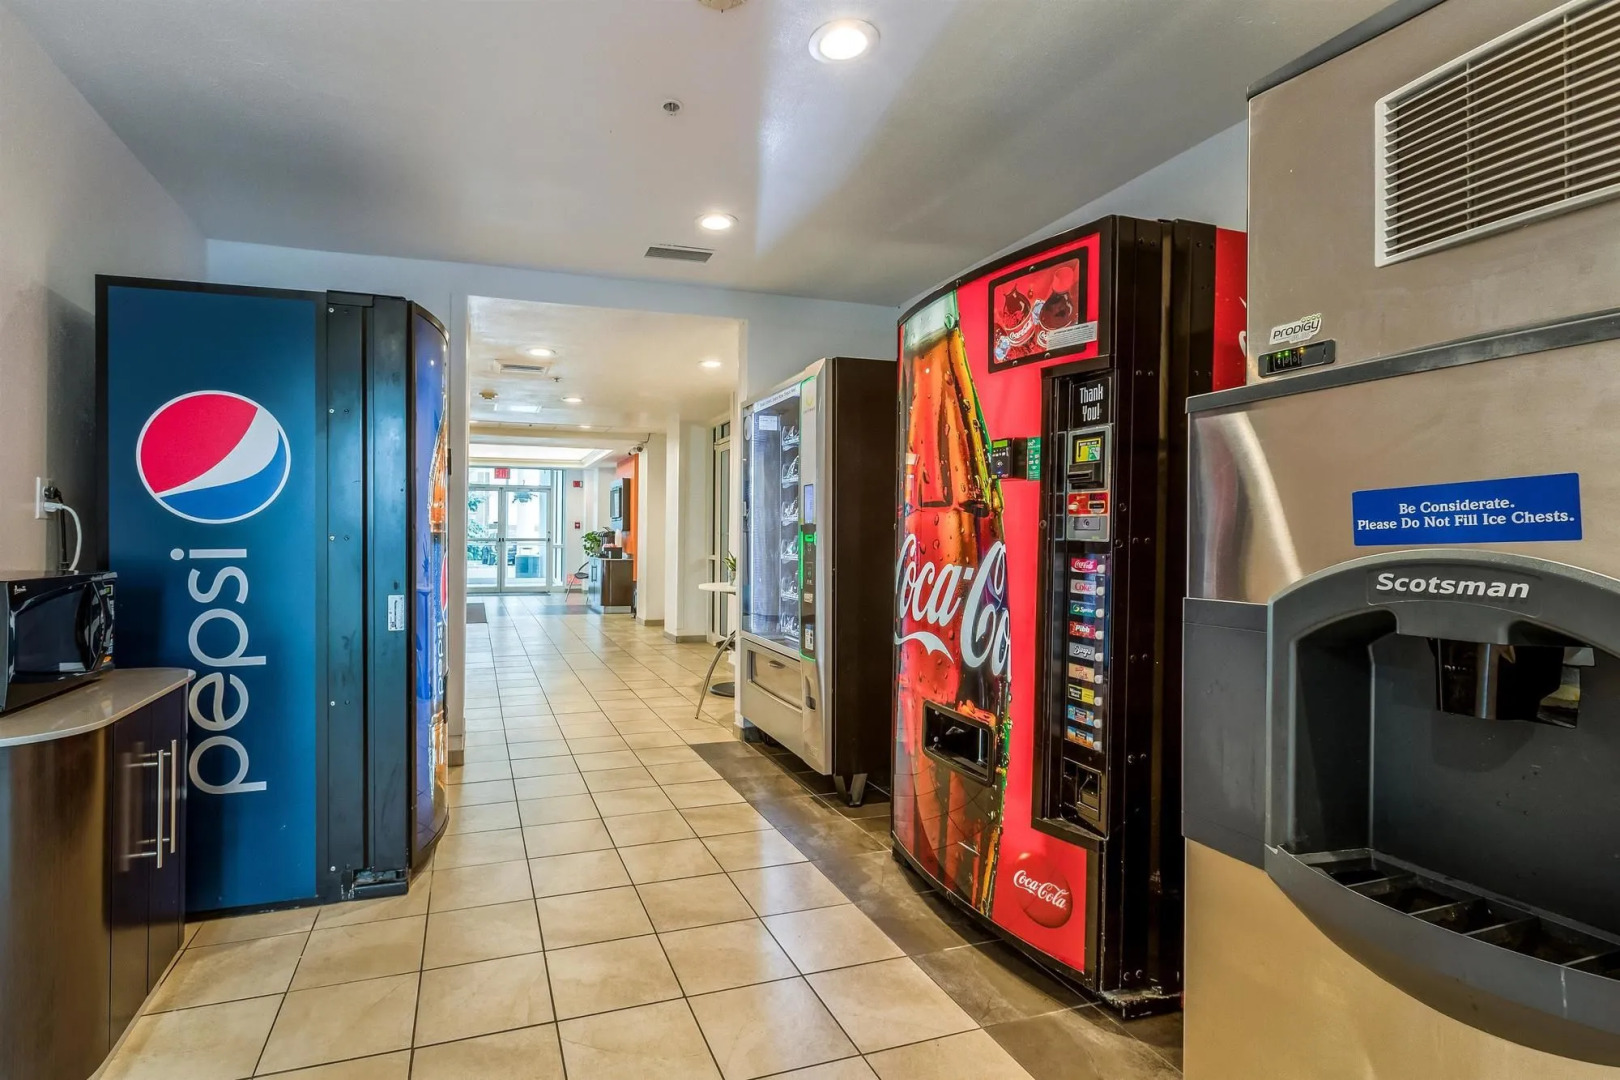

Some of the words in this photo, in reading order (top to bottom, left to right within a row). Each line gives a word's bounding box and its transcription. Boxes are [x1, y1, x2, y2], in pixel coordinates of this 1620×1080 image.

[1079, 383, 1103, 404] Thank
[1082, 402, 1100, 422] You!
[1398, 503, 1416, 515] Be
[1420, 497, 1515, 513] Considerate.
[1357, 519, 1397, 531] Please
[1401, 517, 1420, 529] Do
[1424, 516, 1450, 528] Not
[1454, 514, 1478, 526] Fill
[1483, 513, 1506, 525] Ice
[1511, 509, 1575, 524] Chests.
[1376, 572, 1530, 599] Scotsman
[170, 547, 267, 795] pepsi
[1013, 869, 1069, 909] Coca-Cola
